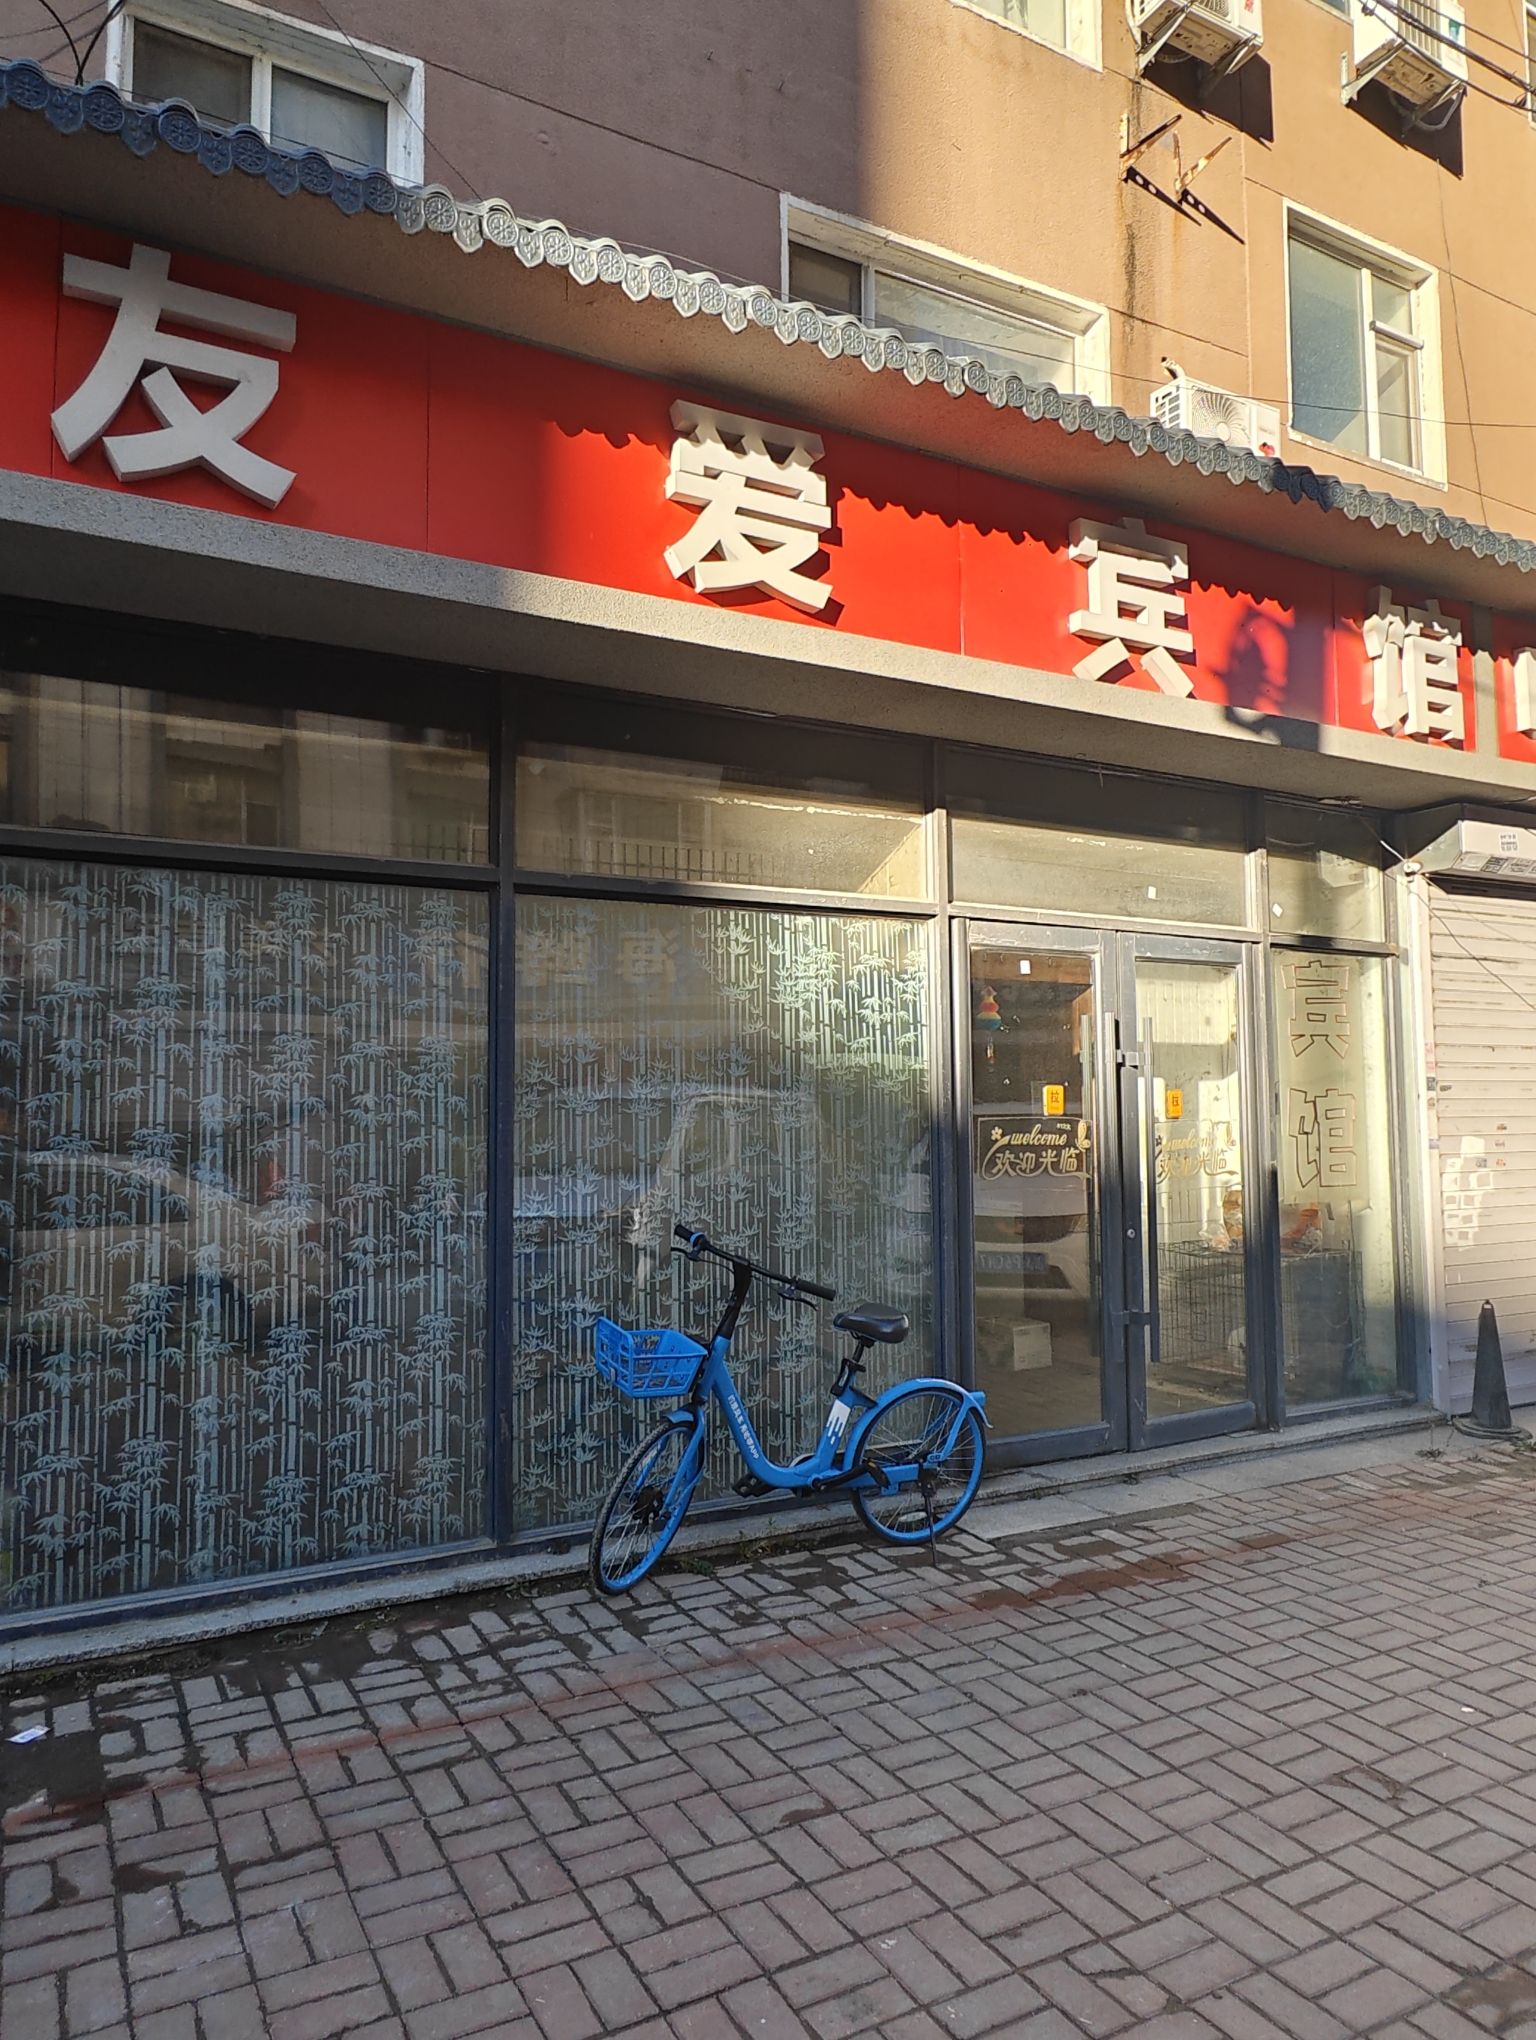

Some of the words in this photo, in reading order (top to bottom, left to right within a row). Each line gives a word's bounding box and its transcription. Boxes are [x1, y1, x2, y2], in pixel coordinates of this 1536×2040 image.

[50, 243, 1465, 746] 友爱宾馆
[1010, 1123, 1067, 1146] welcome
[1282, 960, 1358, 1188] 宾馆
[993, 1147, 1080, 1177] 欢迎光临
